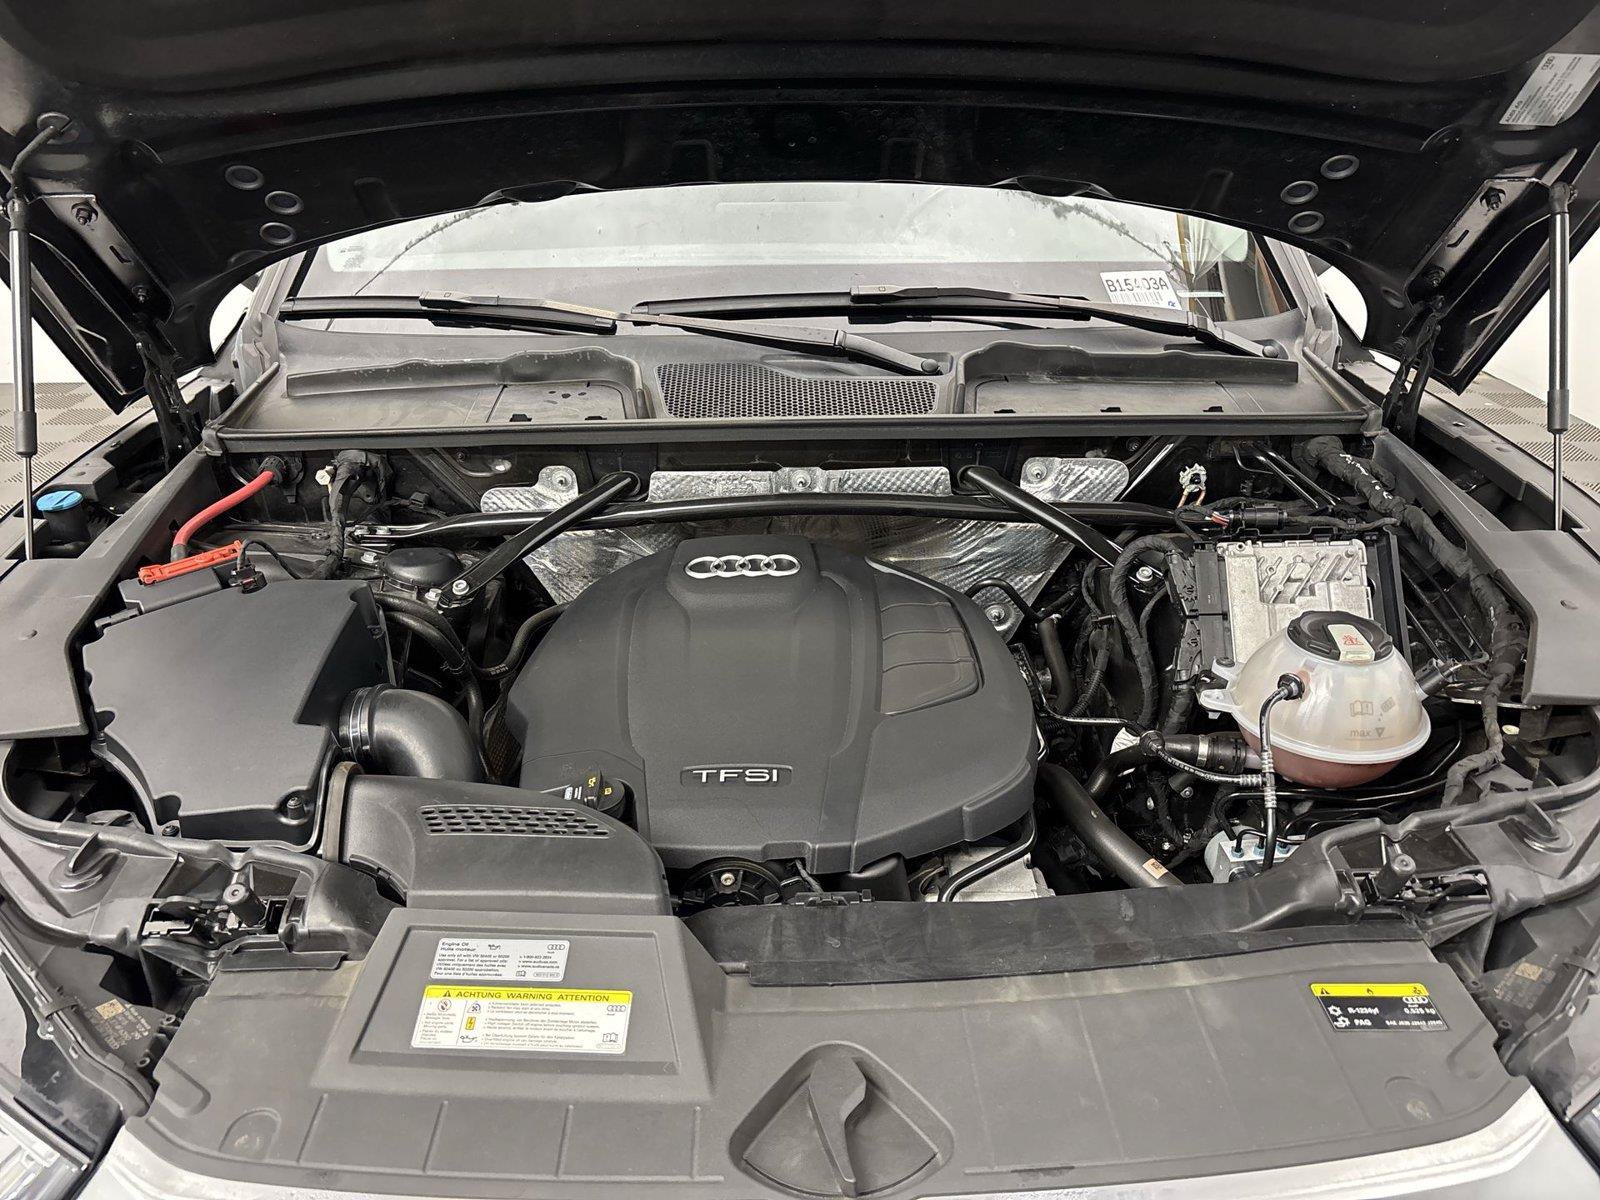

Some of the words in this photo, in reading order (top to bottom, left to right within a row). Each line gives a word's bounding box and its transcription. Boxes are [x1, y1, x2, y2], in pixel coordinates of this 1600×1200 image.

[1350, 728, 1372, 737] max
[692, 768, 778, 783] TFSI
[456, 991, 501, 999] ACHTUNG
[507, 992, 553, 1000] WARNING
[558, 994, 610, 1002] ATTENTION
